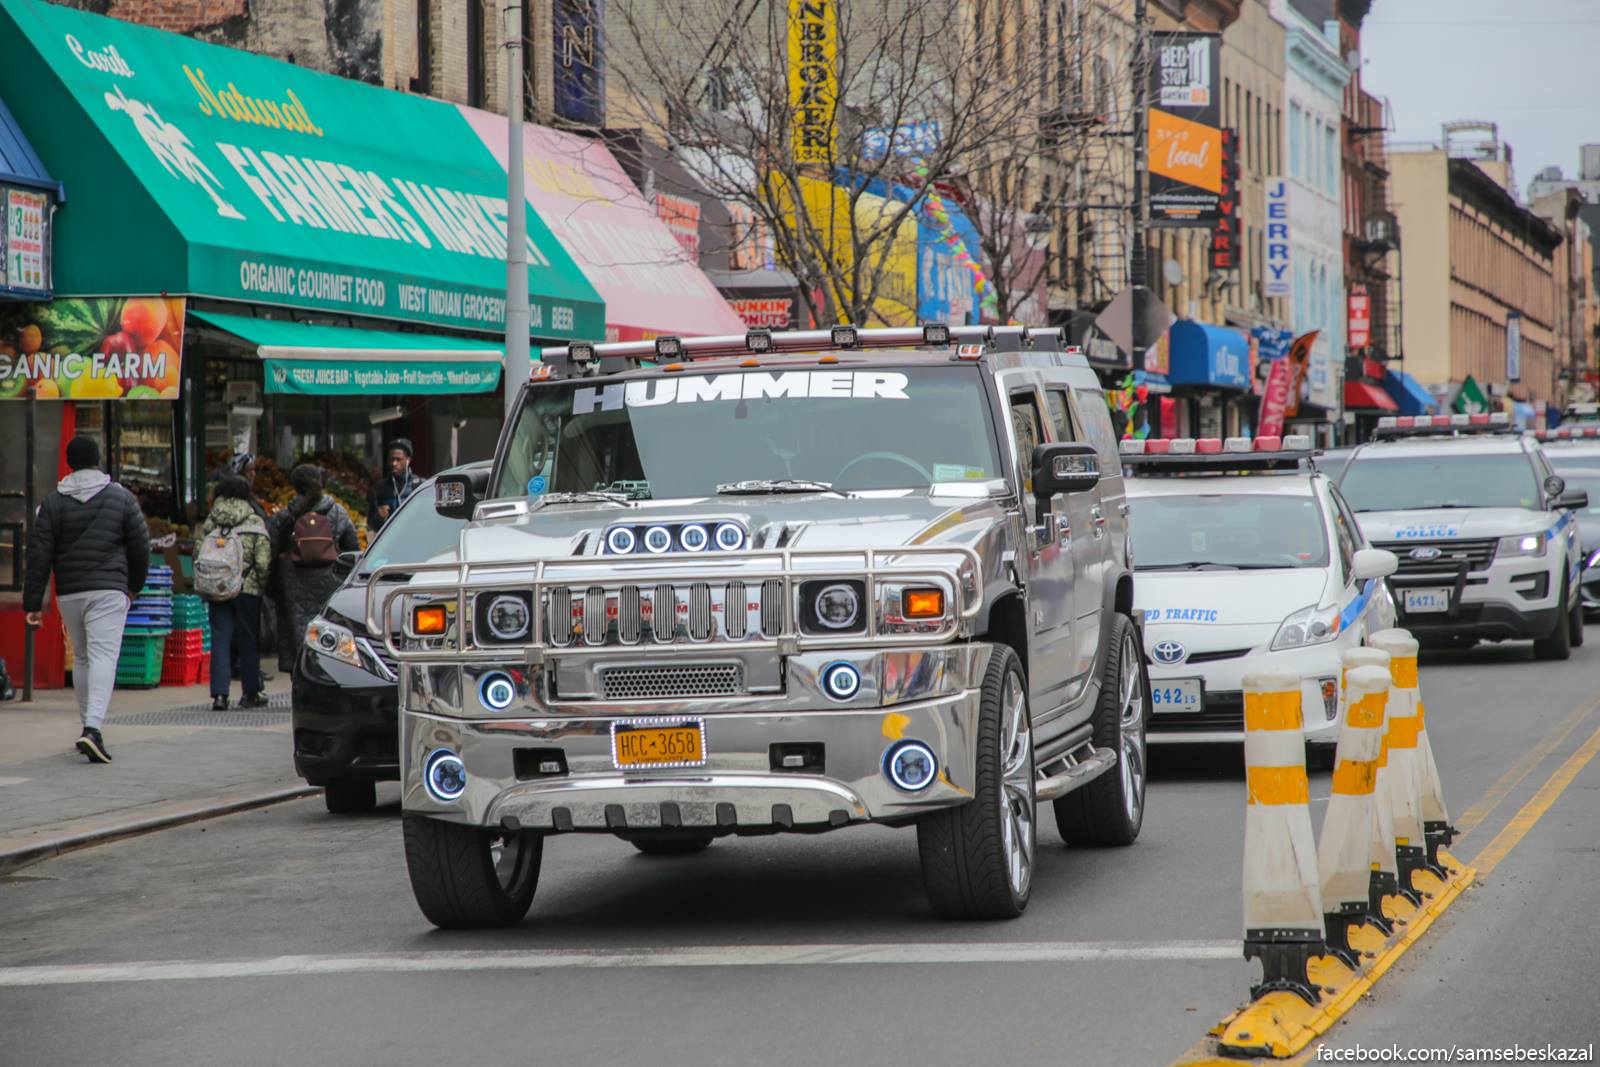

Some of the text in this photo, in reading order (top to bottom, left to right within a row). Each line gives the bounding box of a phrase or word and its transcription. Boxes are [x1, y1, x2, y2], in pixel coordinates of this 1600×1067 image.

[1161, 68, 1188, 85] STUY
[181, 64, 324, 137] Natural
[1268, 182, 1289, 280] JERRY
[240, 260, 574, 330] ORGANIC GOURMET FOOD WEST INDIAN GROCERY DA BEER
[739, 313, 789, 327] ONUTS
[91, 352, 167, 380] FARM
[572, 371, 911, 415] HUMMER
[1395, 528, 1457, 538] POLICE
[1143, 608, 1218, 621] PD TRAFFIC
[1152, 688, 1182, 704] 642
[621, 731, 696, 757] HCC 3658
